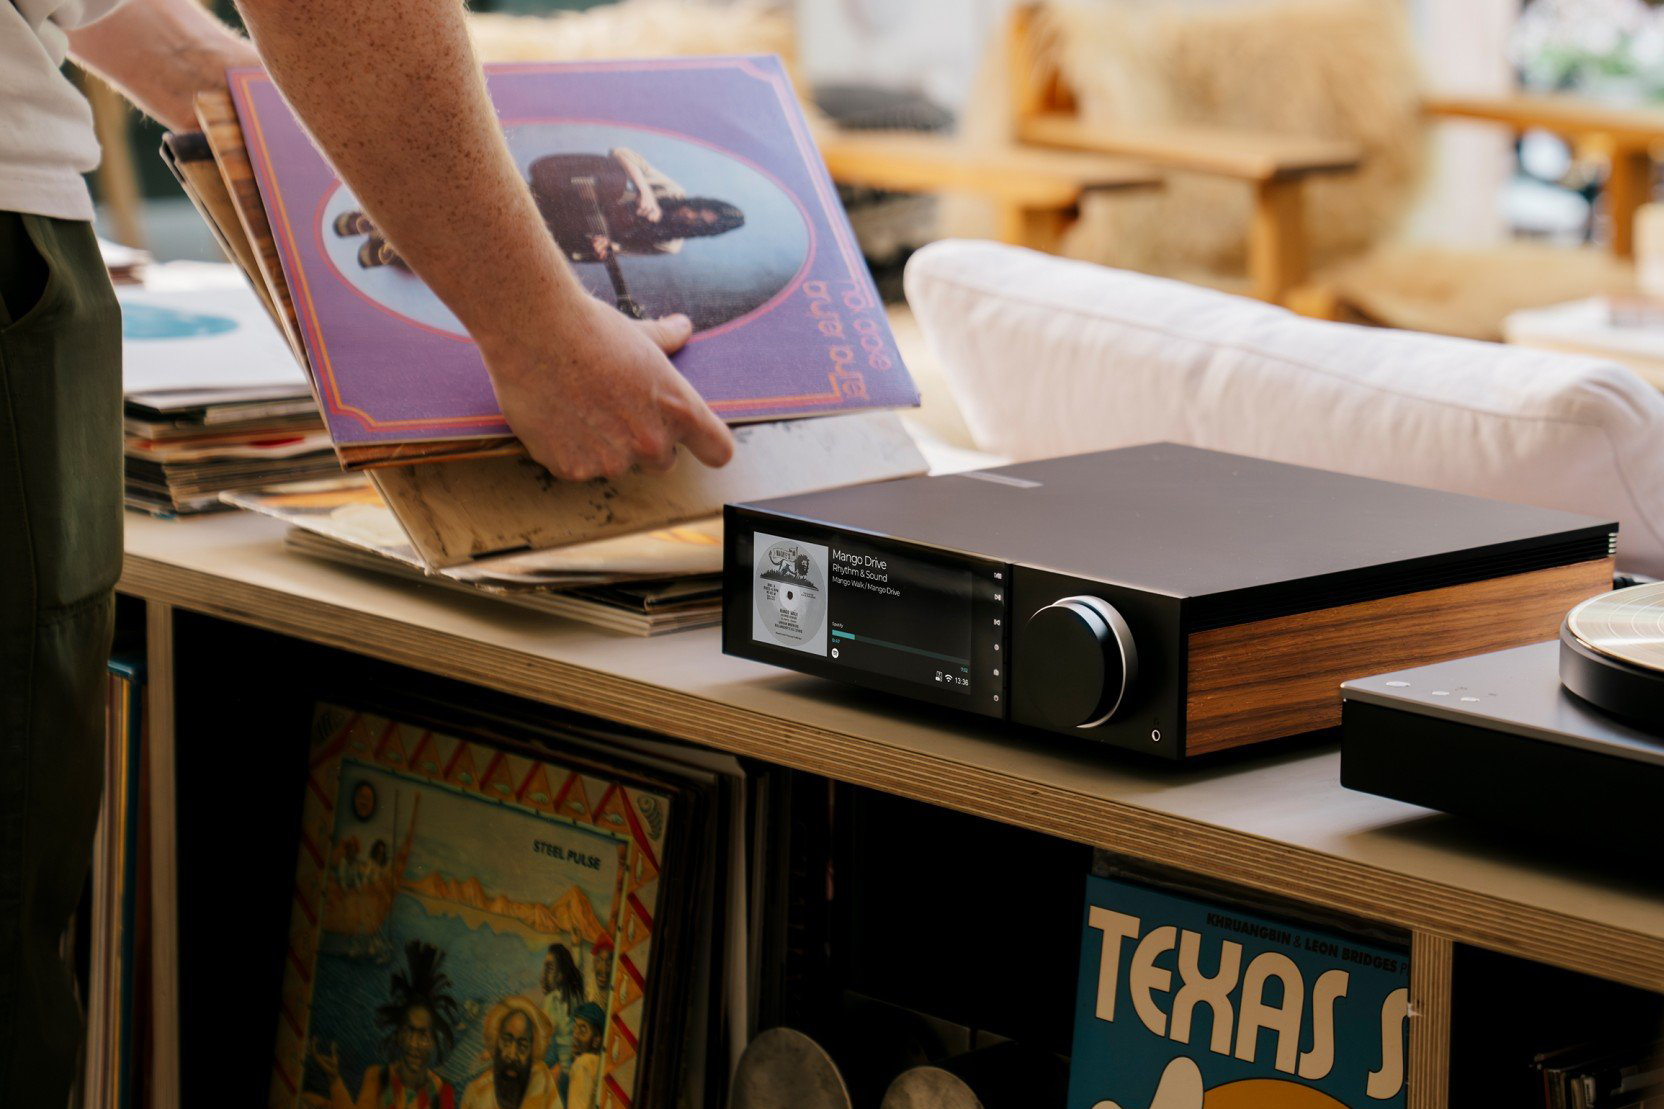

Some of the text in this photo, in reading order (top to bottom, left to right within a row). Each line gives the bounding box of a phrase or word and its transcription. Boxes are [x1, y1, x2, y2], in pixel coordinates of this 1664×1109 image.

[832, 548, 887, 570] Mango Drive
[832, 563, 888, 583] Rhythm & Sound
[832, 576, 851, 587] Mango
[851, 580, 865, 589] Walk
[867, 583, 886, 594] Mango
[886, 587, 901, 597] Drive
[533, 839, 601, 871] STEEL PULSE
[1206, 912, 1292, 945] KHRUANGBIN
[1293, 935, 1301, 948] &
[1304, 938, 1338, 957] LEON
[1341, 948, 1398, 973] BRIDGES
[1088, 904, 1350, 1081] TEXAS
